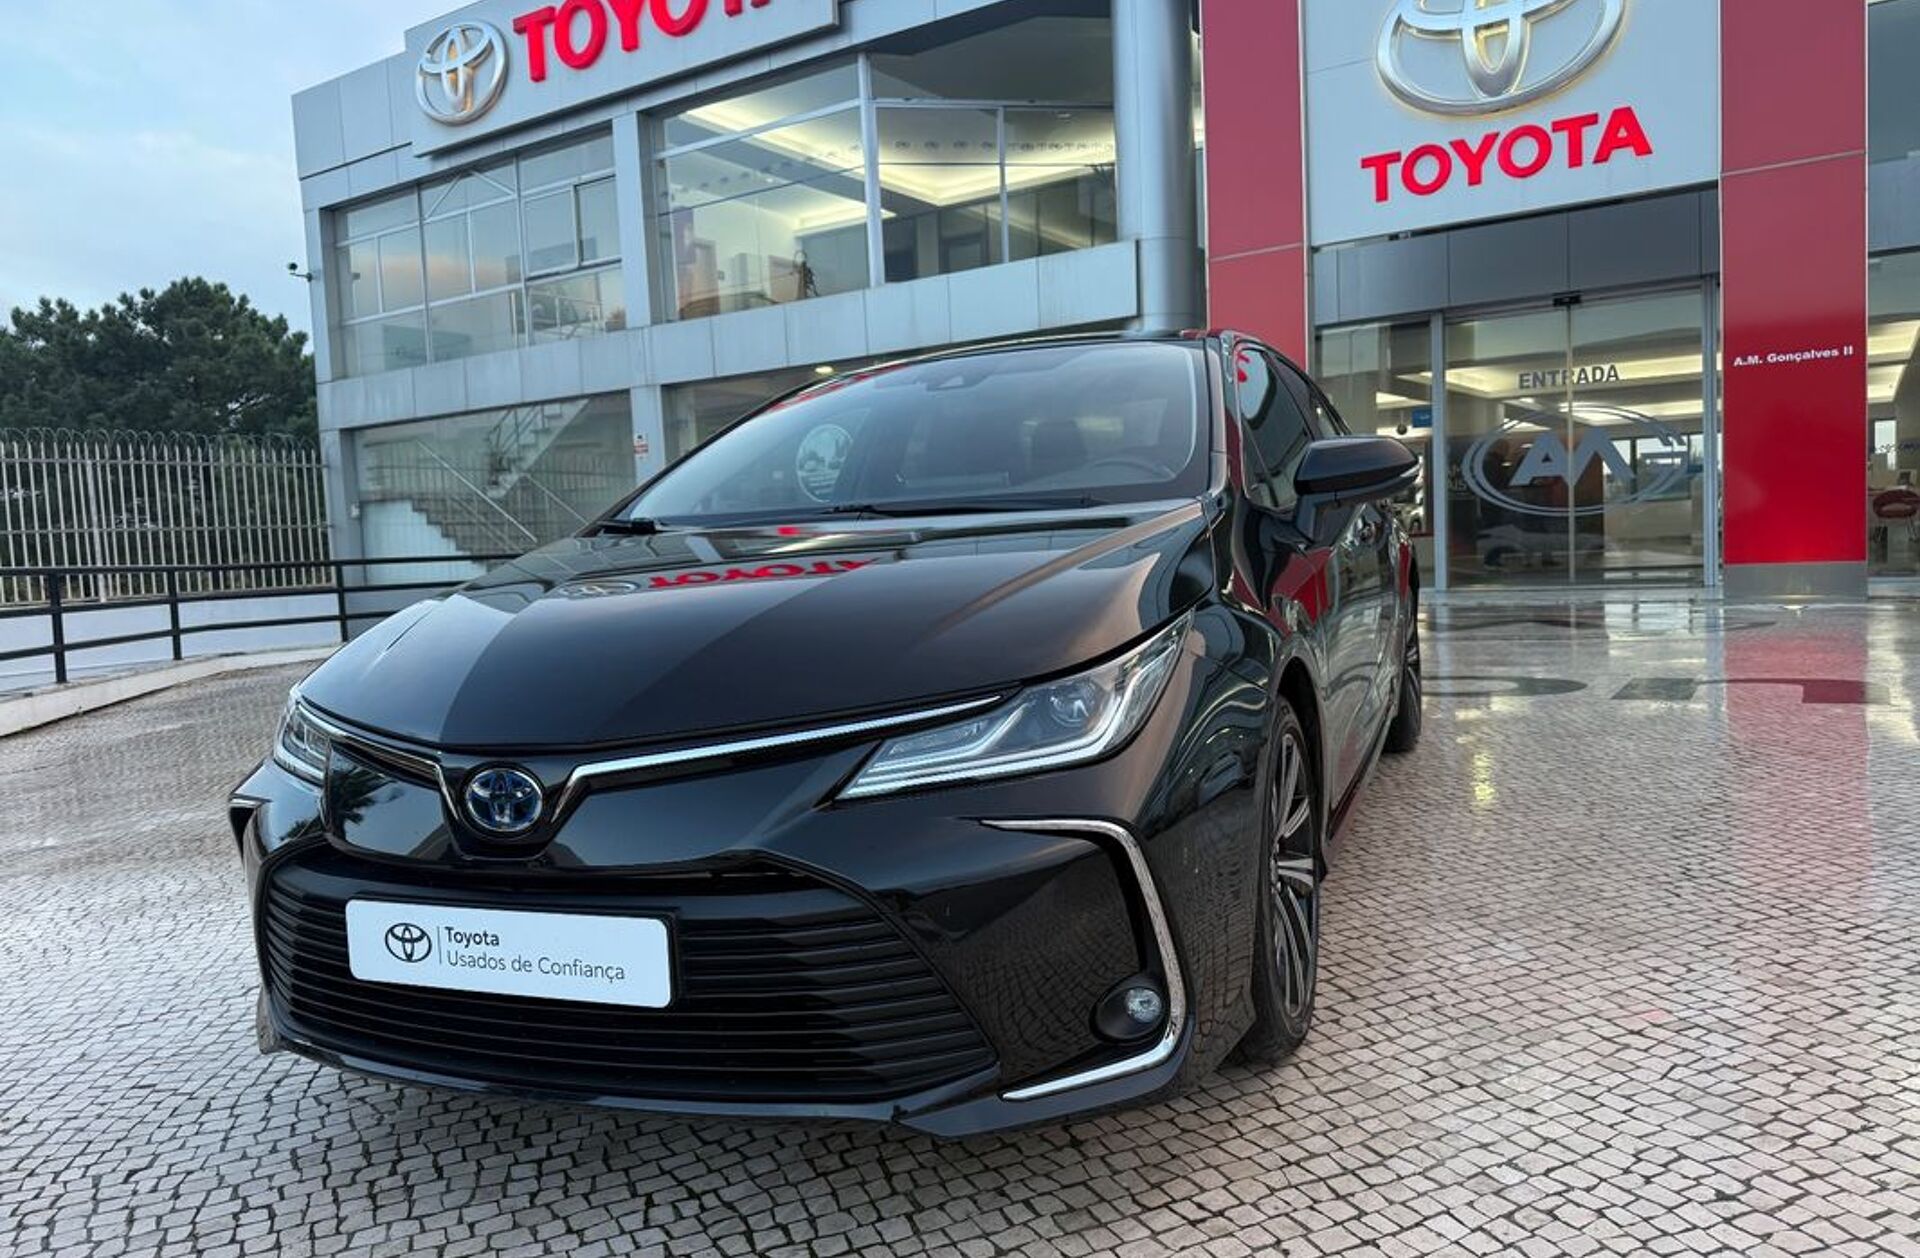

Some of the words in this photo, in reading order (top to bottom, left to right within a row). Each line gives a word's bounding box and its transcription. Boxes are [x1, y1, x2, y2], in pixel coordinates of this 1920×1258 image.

[1361, 106, 1653, 203] TOYOTA
[1733, 355, 1763, 367] A.M.
[1766, 348, 1839, 363] Gonçalves
[1843, 345, 1854, 356] II
[444, 926, 500, 948] Toyota
[447, 950, 507, 971] Usados
[511, 955, 533, 973] de
[538, 956, 625, 983] Confiança
